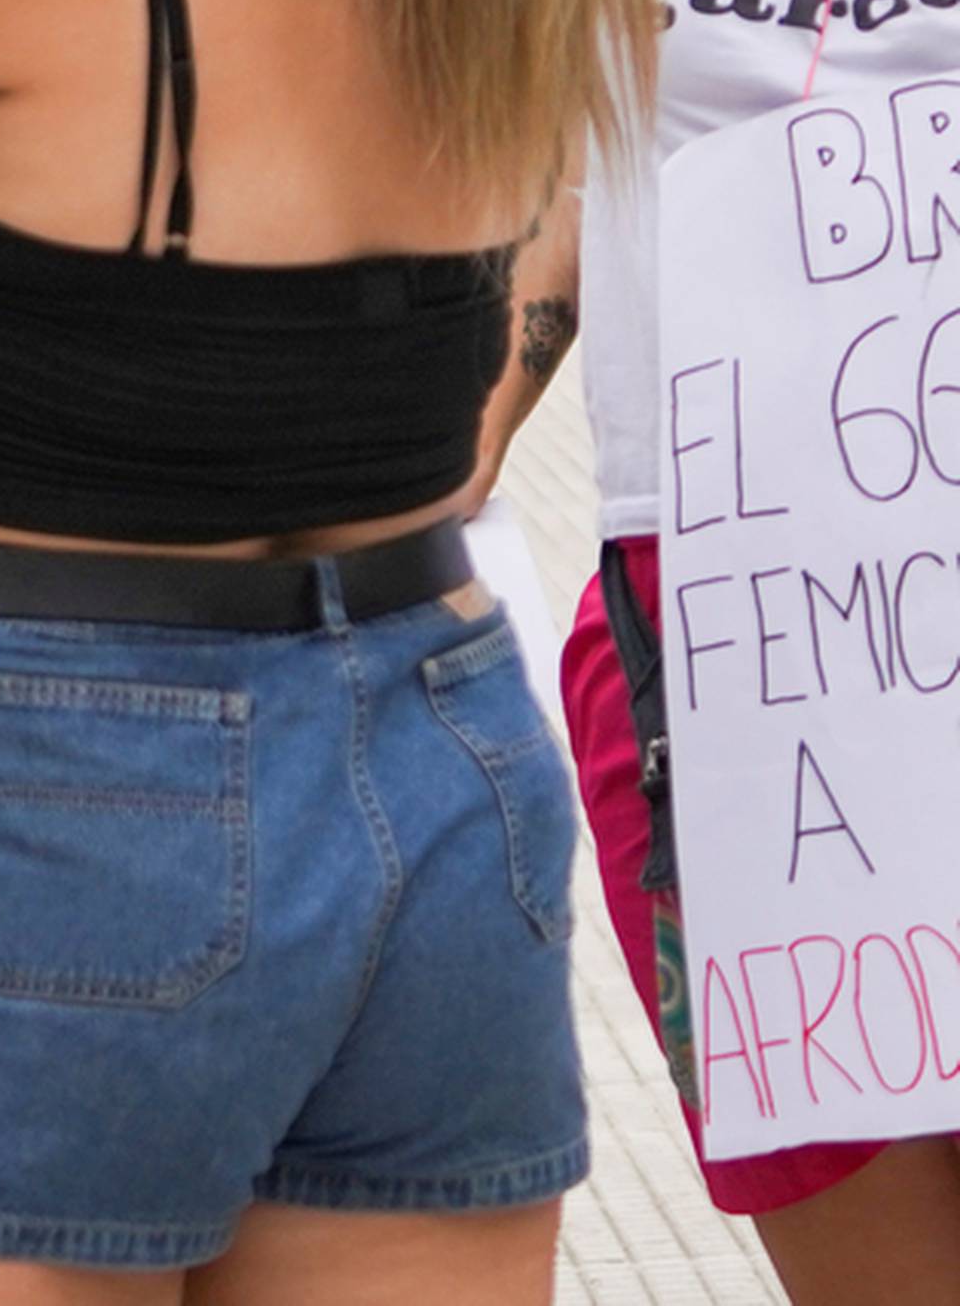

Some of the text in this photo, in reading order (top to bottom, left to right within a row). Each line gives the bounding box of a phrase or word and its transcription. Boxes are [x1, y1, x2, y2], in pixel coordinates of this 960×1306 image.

[670, 358, 789, 535] EL
[677, 552, 960, 712] FEMIC
[787, 738, 876, 884] A
